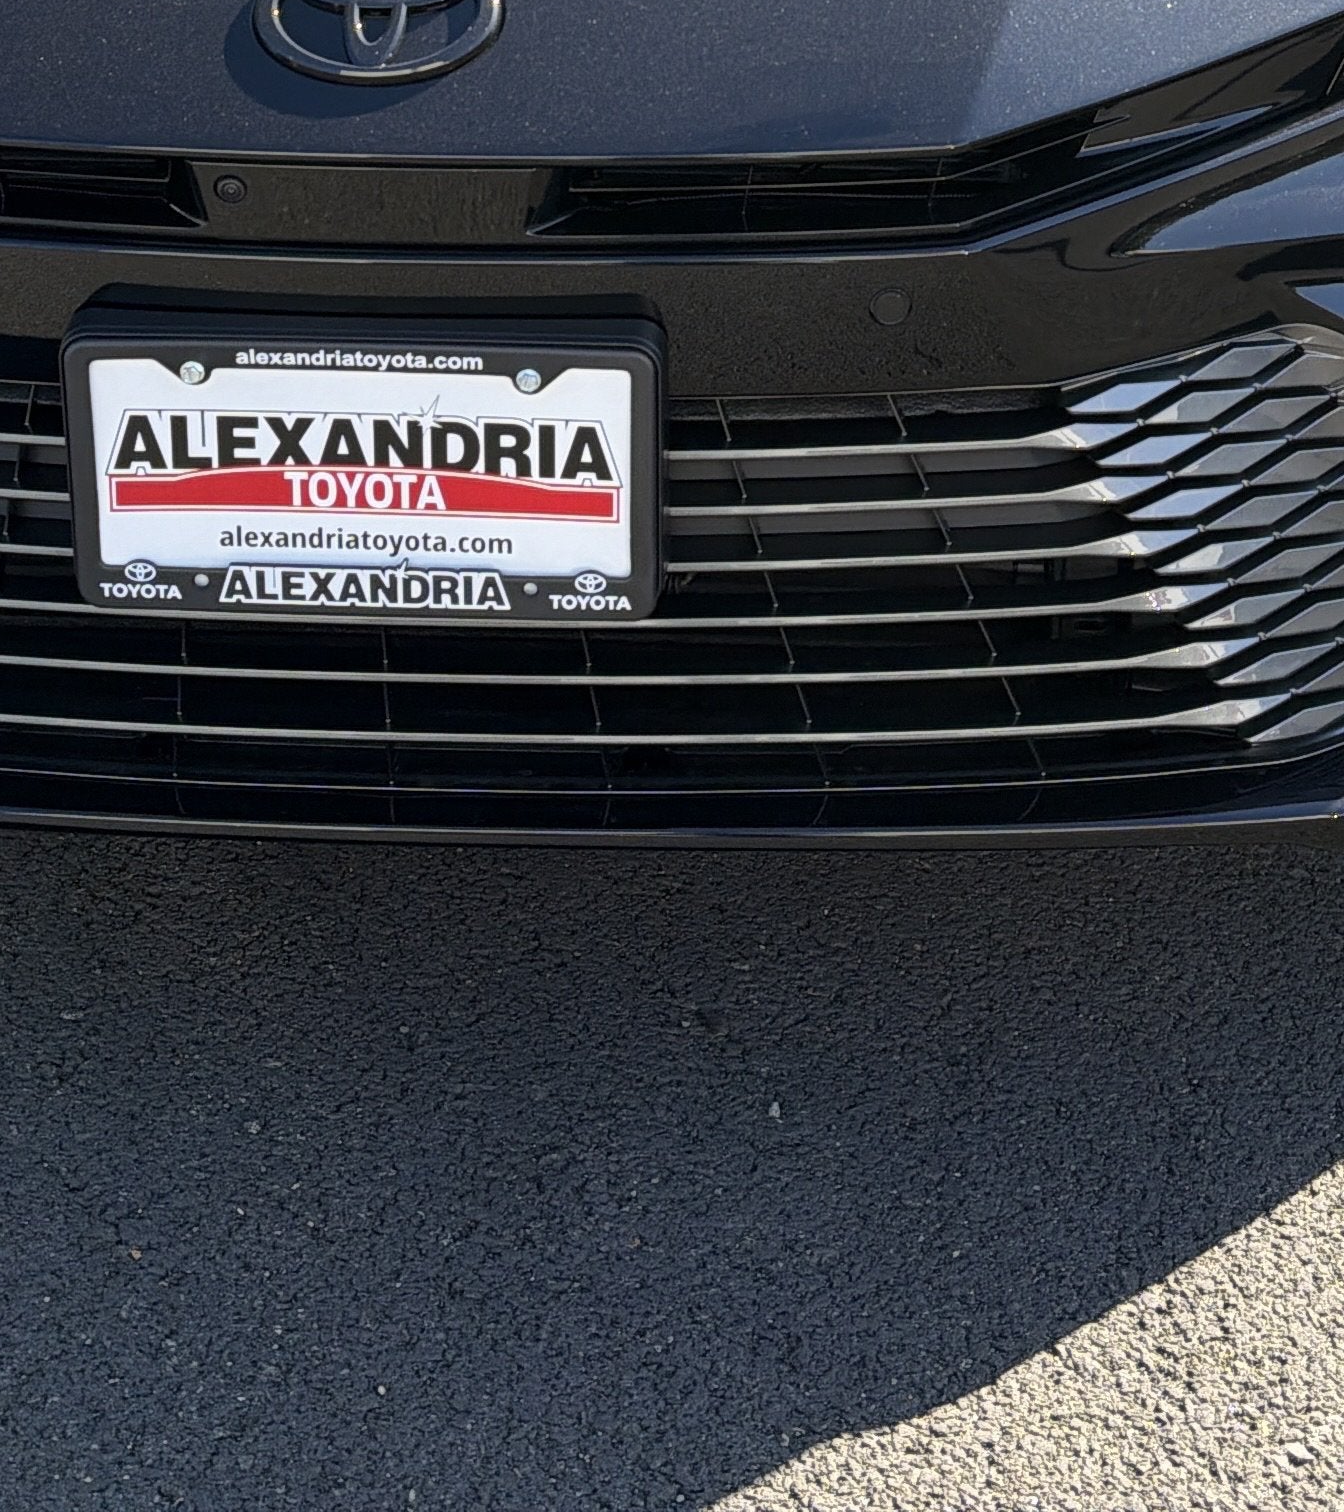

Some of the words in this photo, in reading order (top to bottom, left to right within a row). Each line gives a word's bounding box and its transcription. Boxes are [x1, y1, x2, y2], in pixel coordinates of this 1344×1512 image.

[235, 348, 484, 372] alexandriatoyota.com
[112, 410, 616, 483] ALEXANDRIA
[283, 471, 447, 511] TOYOTA
[219, 525, 513, 558] alexandriatoyota.com
[99, 582, 183, 601] TOYOTA
[219, 565, 512, 611] ALEXANDRIA
[548, 594, 633, 612] TOYOTA
